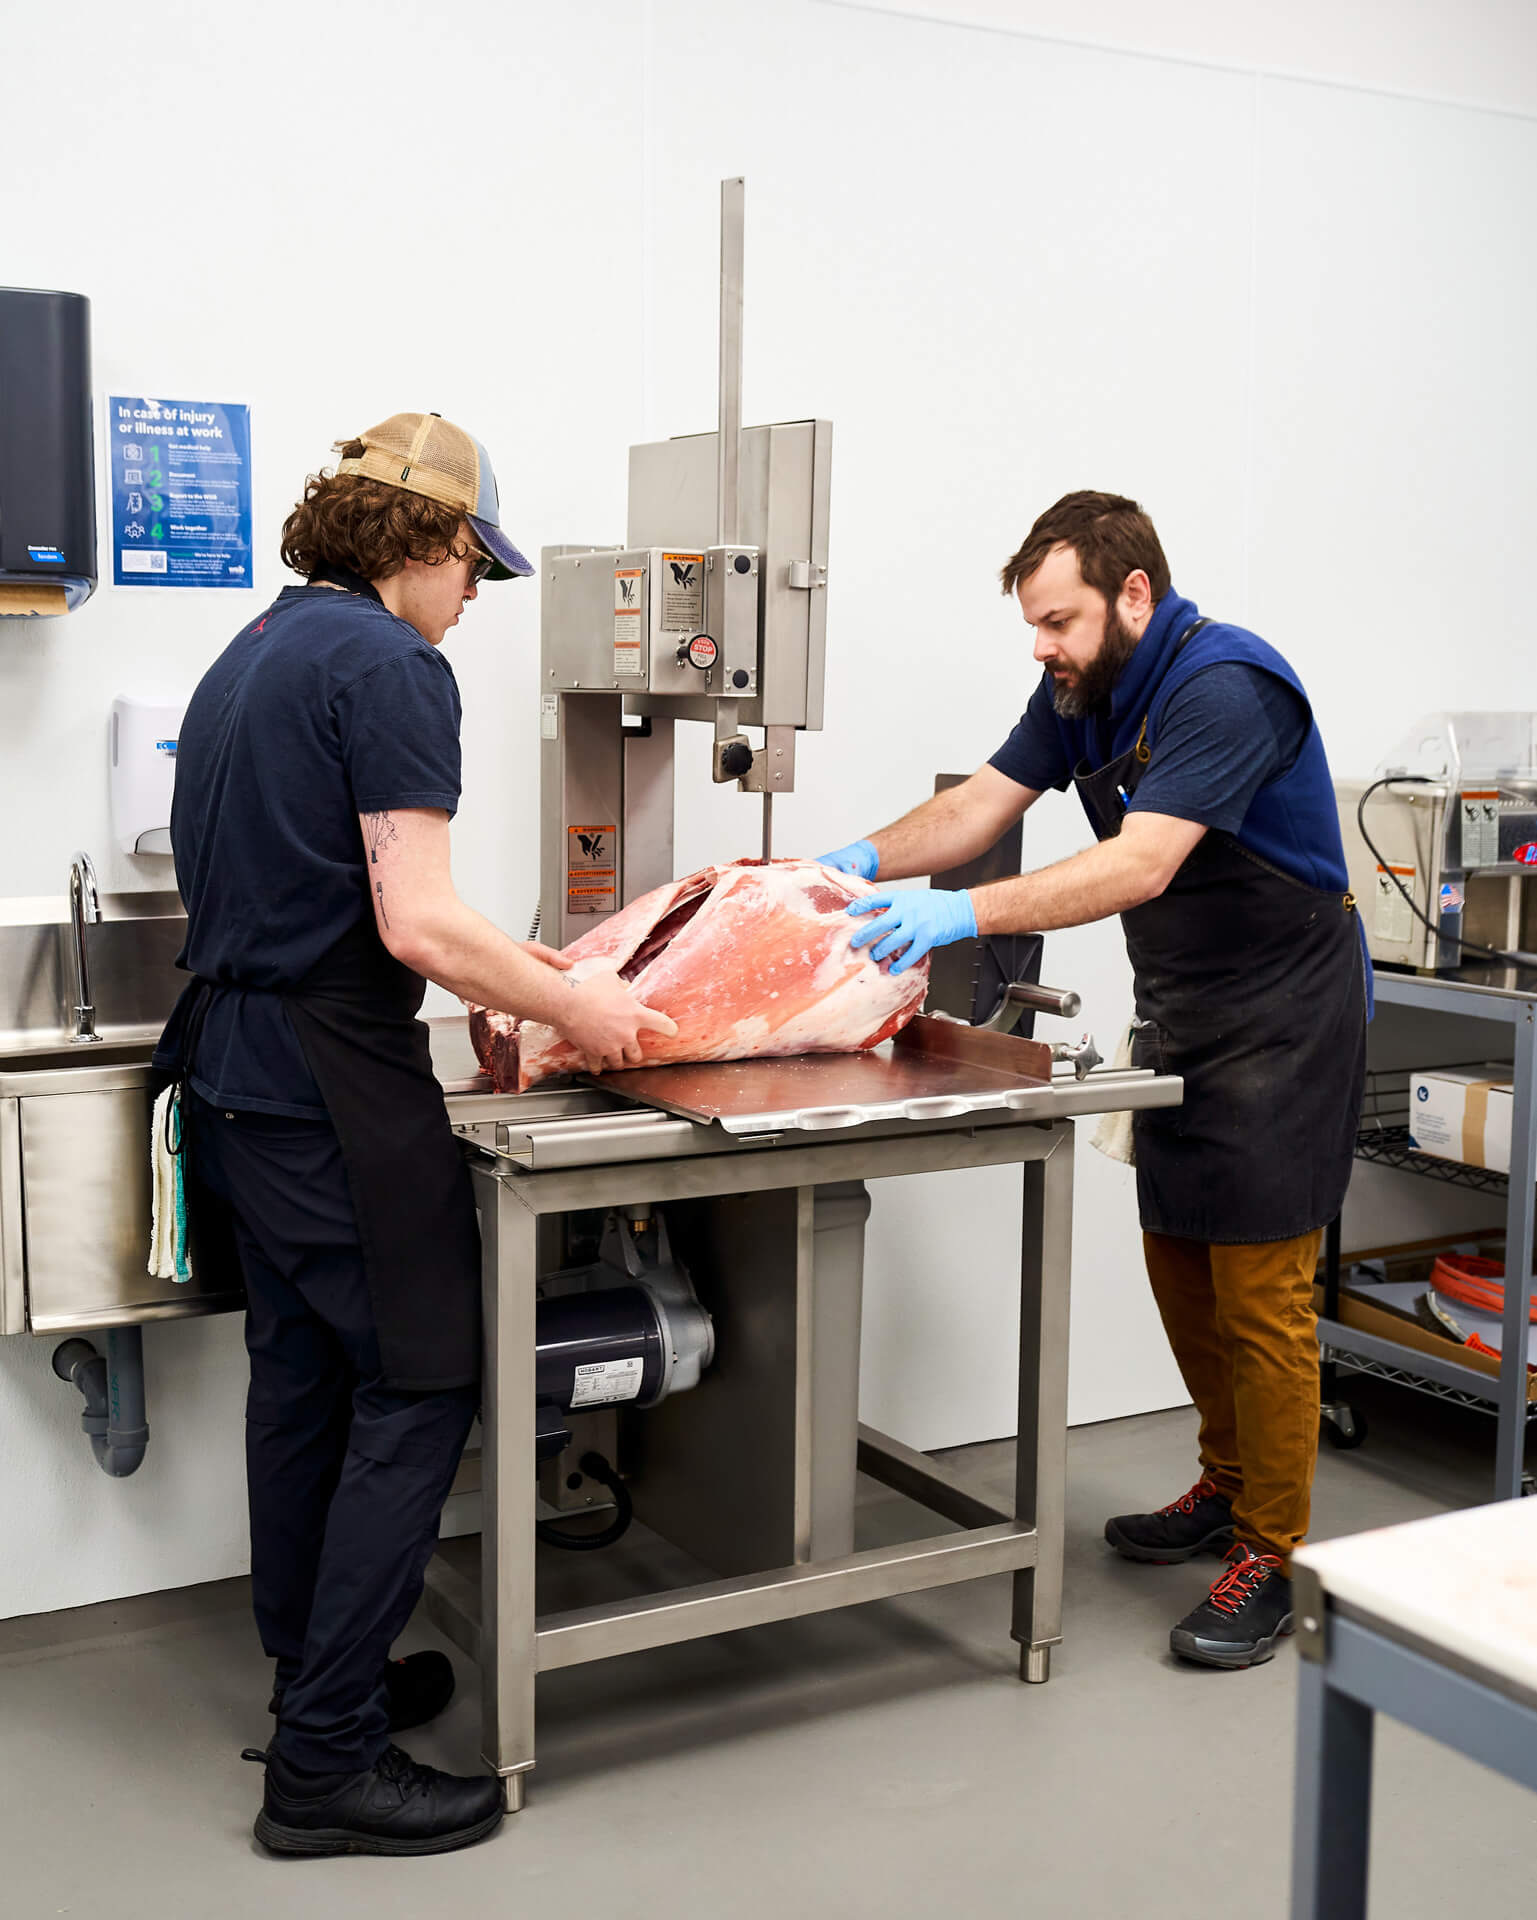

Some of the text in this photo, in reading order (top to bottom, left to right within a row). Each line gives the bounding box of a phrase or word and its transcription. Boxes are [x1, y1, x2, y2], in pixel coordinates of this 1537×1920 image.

[118, 405, 215, 426] In case of injury
[118, 422, 223, 439] or illness at work
[150, 445, 159, 463] 1
[149, 470, 163, 487] 2
[150, 494, 163, 512] 3
[150, 523, 164, 540] 4
[694, 644, 713, 653] STOP
